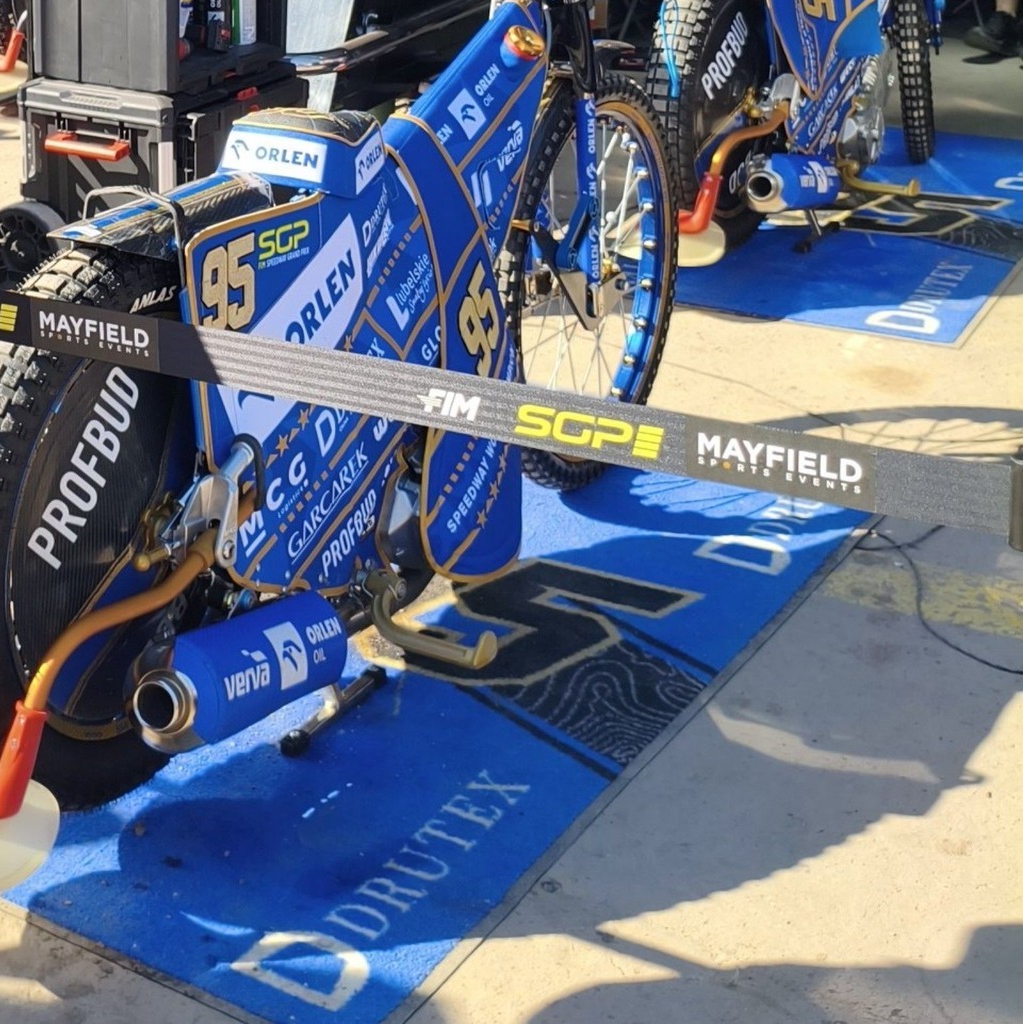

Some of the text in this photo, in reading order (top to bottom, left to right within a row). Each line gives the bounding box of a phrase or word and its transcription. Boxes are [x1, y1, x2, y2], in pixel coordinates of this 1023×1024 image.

[475, 63, 500, 96] ORLEN
[701, 11, 750, 100] PROFBUD
[484, 95, 494, 107] OIL
[255, 146, 319, 168] ORLEN
[259, 220, 309, 260] SGP
[129, 287, 177, 314] ANLAS
[202, 233, 255, 330] 95
[285, 249, 355, 344] ORLEN
[459, 260, 499, 377] 95
[39, 311, 150, 348] MAYFIELD
[40, 330, 150, 357] SPORTS EVENTS
[27, 366, 140, 570] PROFBUD
[418, 388, 863, 483] FIM SGP MAYFIELD
[697, 456, 863, 494] SPORTS EVENTS
[288, 443, 369, 558] GARCAREK
[323, 489, 377, 577] PROFBUD
[447, 458, 489, 533] SPEEDWAY
[224, 616, 341, 701] verva ORLEN
[313, 649, 326, 665] OIL
[323, 769, 532, 940] DRUTEX
